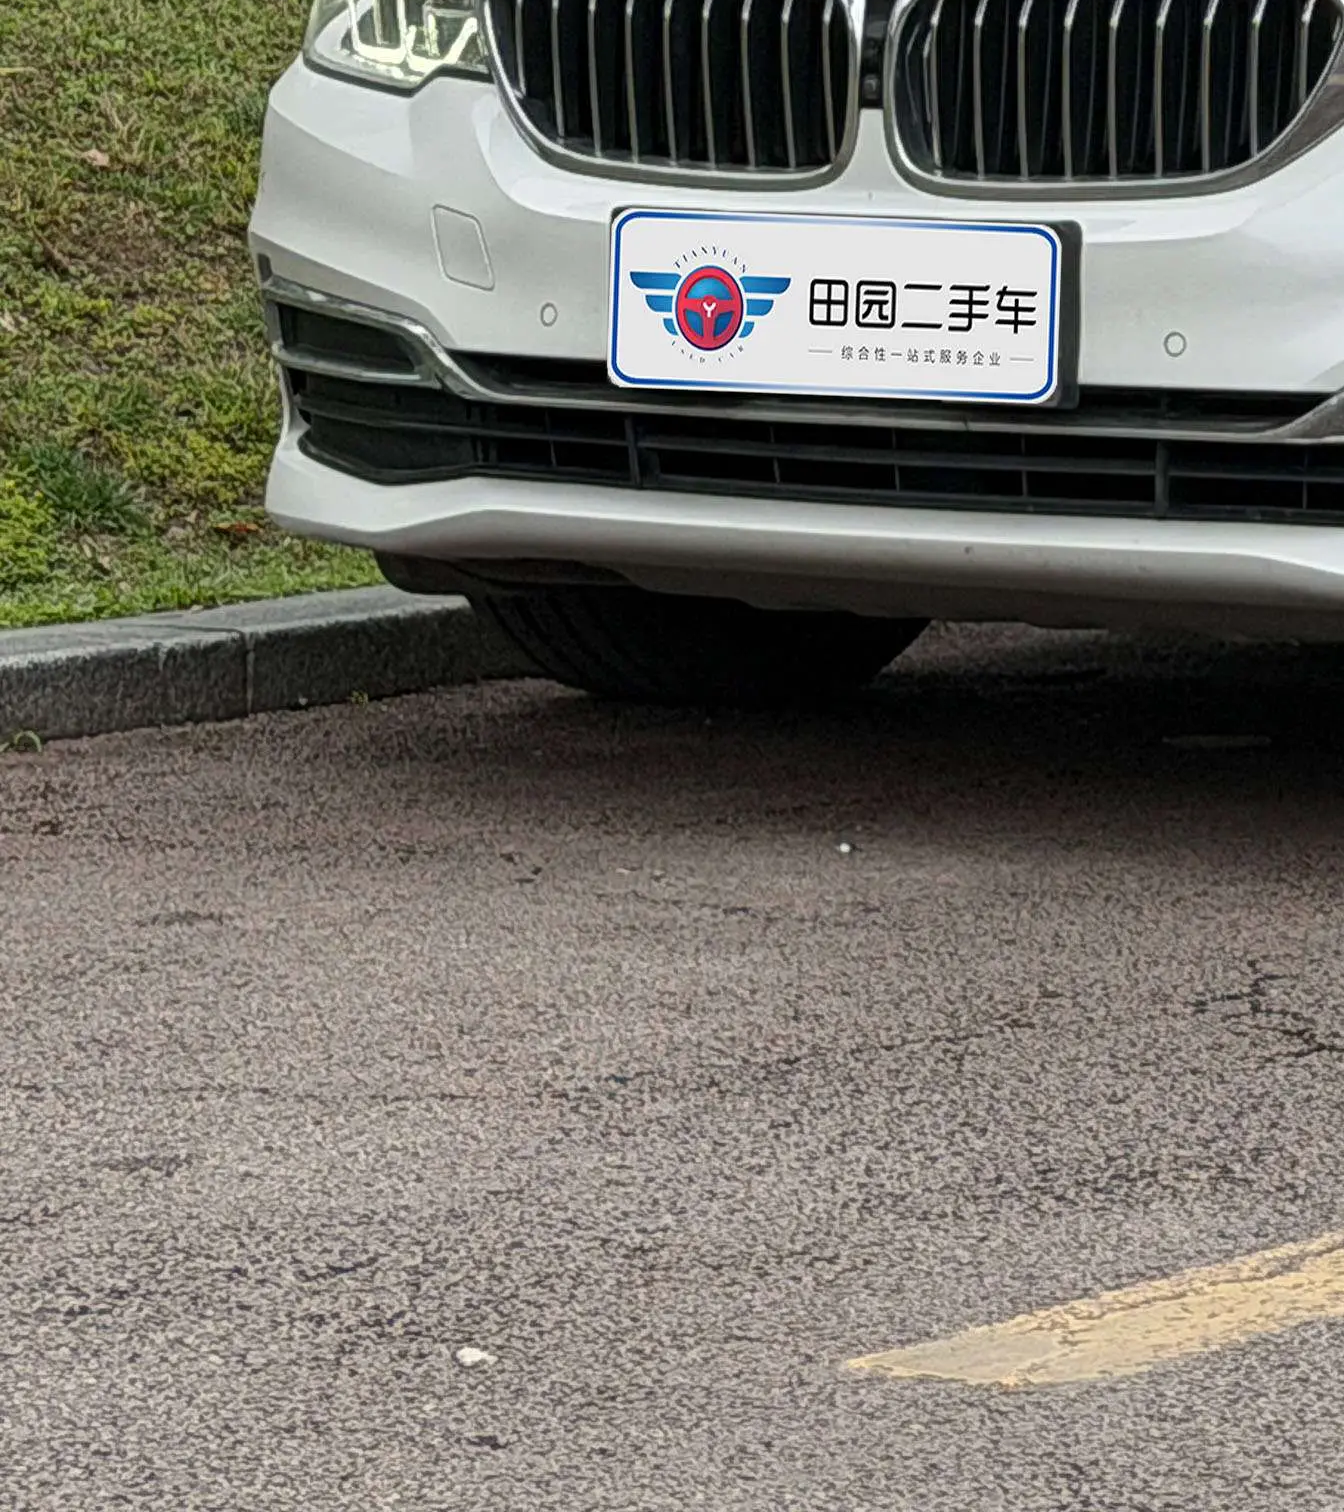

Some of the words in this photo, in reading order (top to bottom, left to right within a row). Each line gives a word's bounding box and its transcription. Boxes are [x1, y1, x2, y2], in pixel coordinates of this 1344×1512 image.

[809, 278, 1038, 335] 田园二手车
[841, 345, 1001, 367] 综合性一站式服务企业
